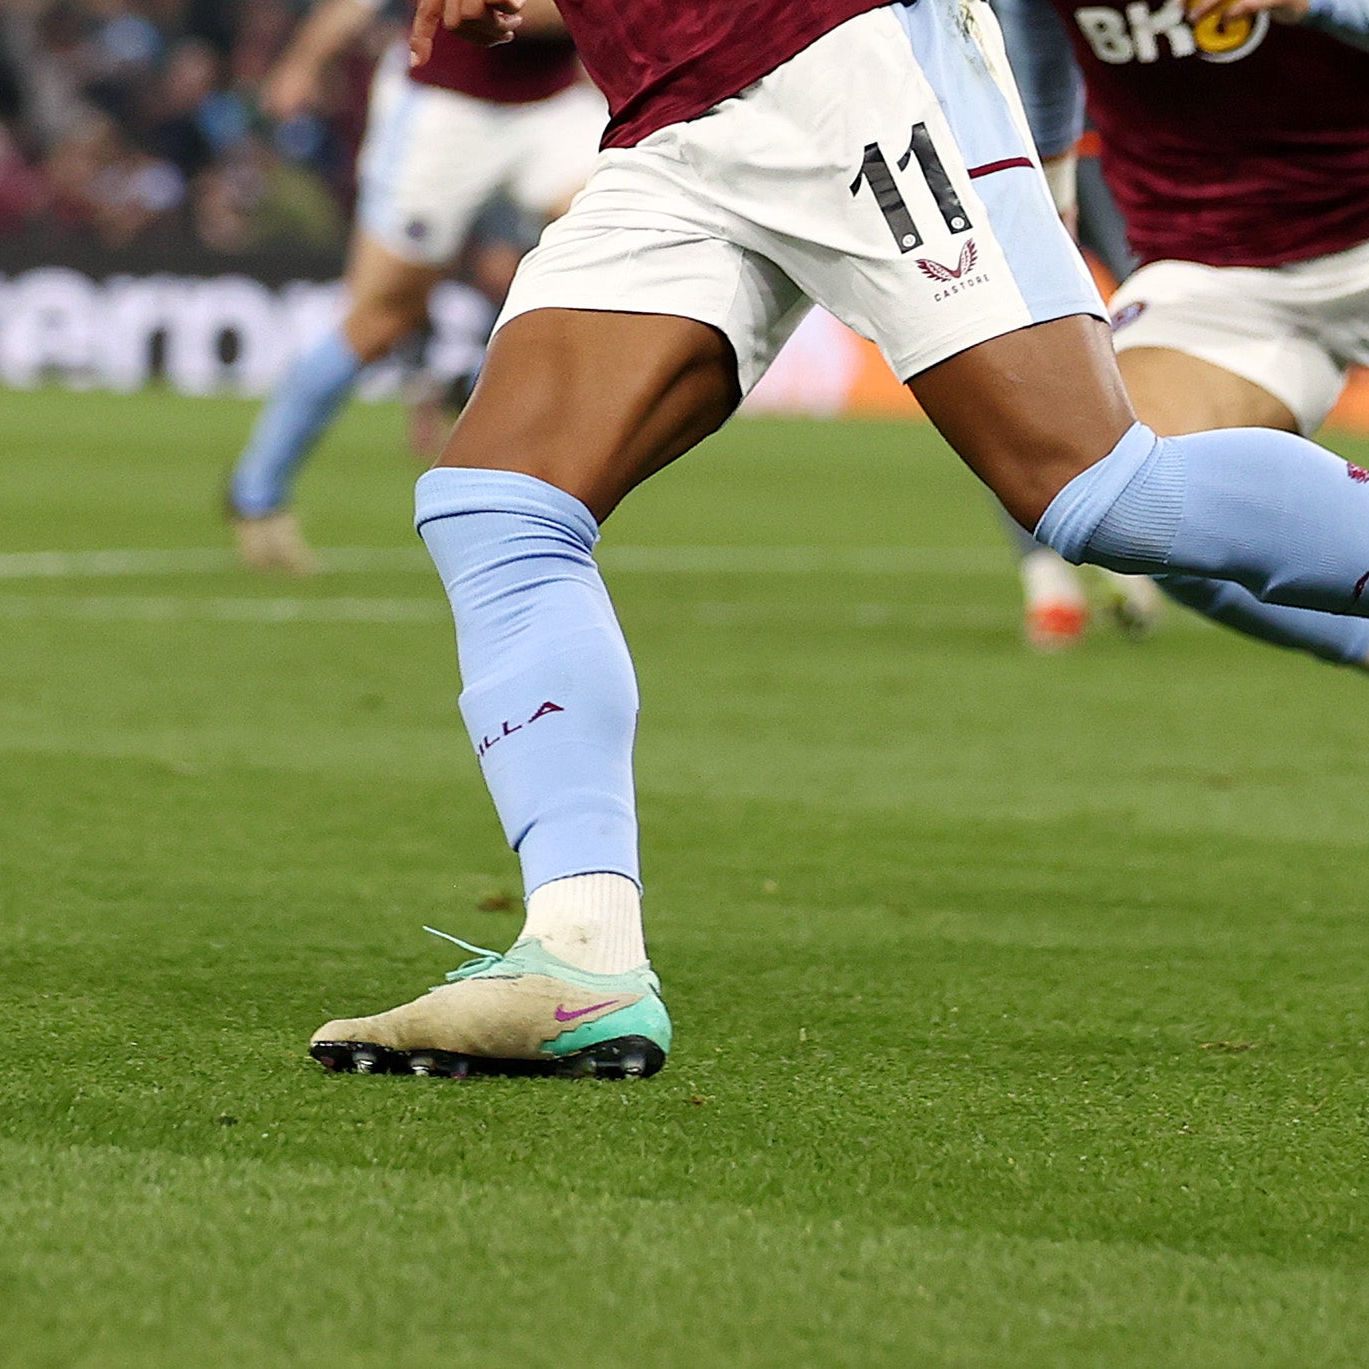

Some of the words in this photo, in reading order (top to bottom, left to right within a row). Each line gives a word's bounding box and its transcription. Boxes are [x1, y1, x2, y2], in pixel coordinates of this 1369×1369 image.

[849, 121, 974, 255] 11
[934, 273, 990, 303] CASTORE
[476, 700, 565, 758] ILLA
